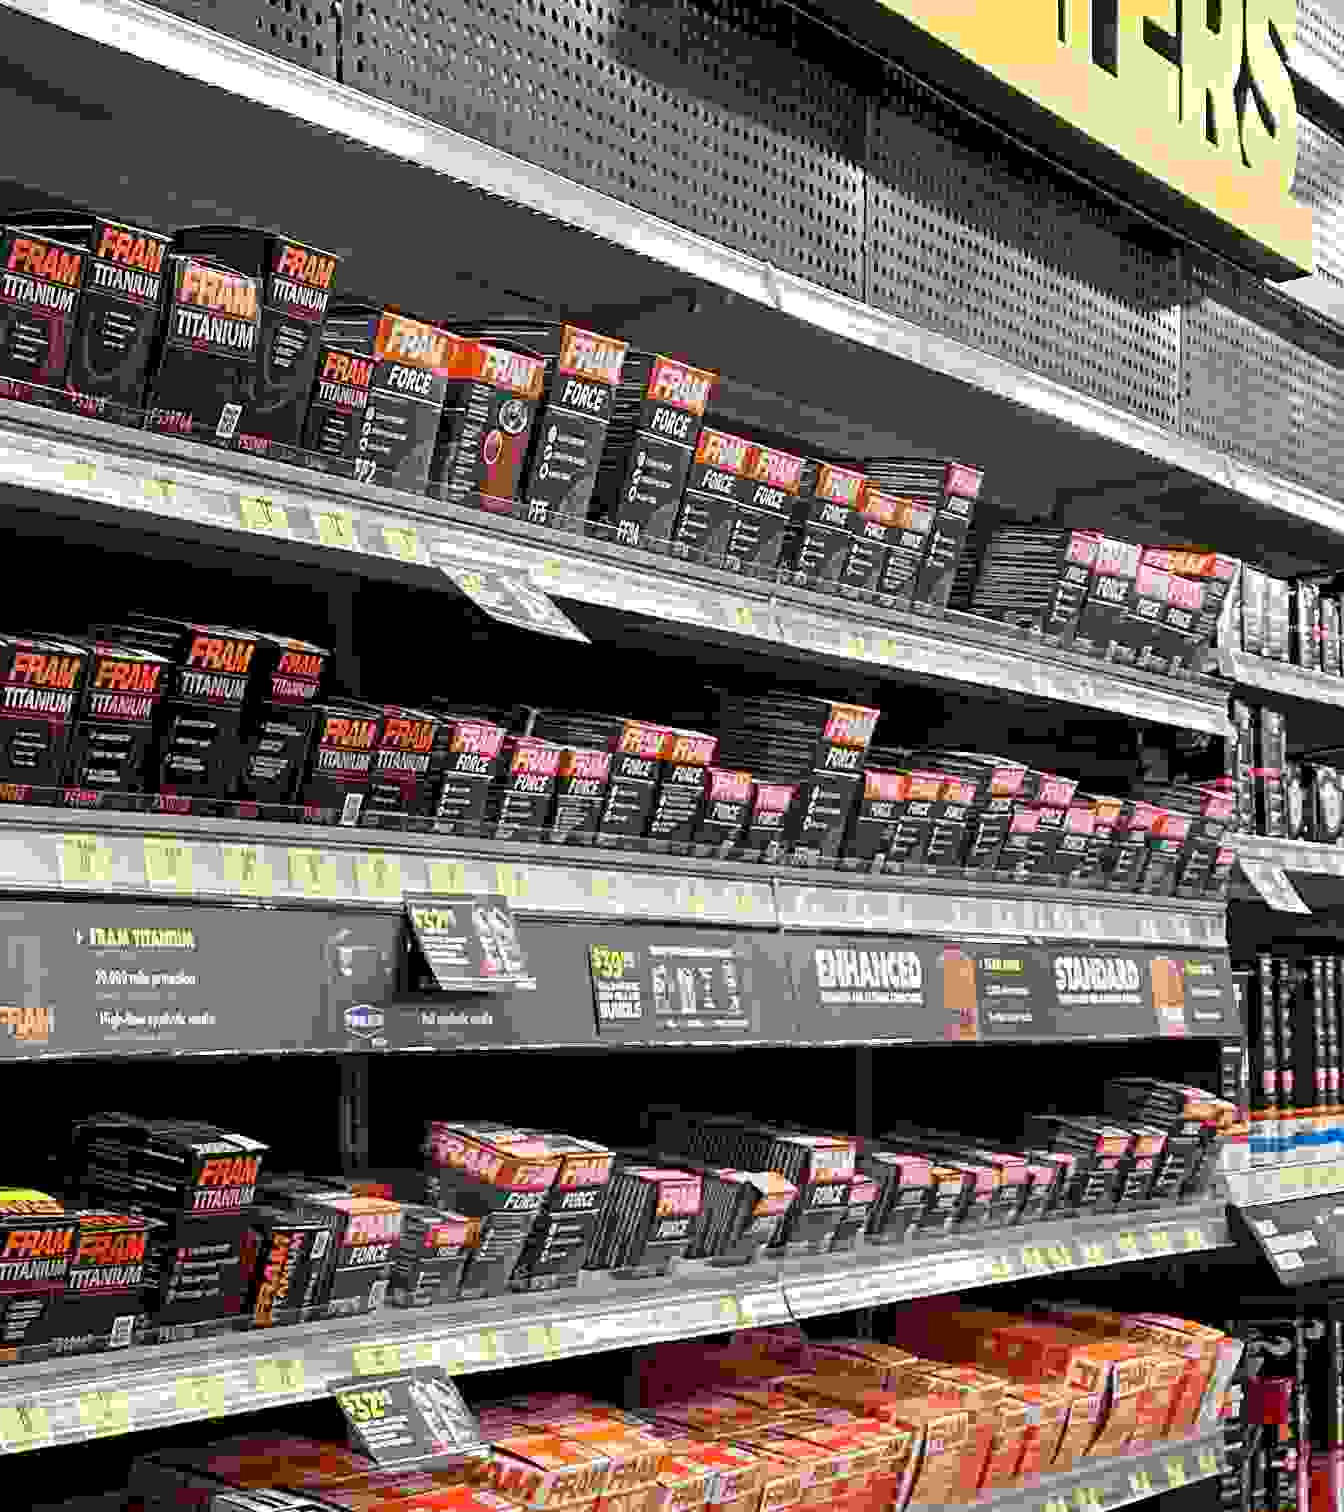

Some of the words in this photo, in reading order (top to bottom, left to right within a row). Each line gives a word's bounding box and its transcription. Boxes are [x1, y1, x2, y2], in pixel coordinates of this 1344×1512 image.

[2, 275, 75, 313] TITANIUM
[176, 311, 255, 349] TITANIUM
[561, 382, 604, 413] FORCE
[651, 407, 690, 440] FORCE
[3, 686, 73, 714] TITANIUM
[184, 673, 245, 698] TITANIUM
[814, 949, 923, 991] ENHANCED
[1053, 956, 1141, 992] STANDARD
[194, 1184, 254, 1209] TITANIUM
[69, 1264, 143, 1289] TITANIUM
